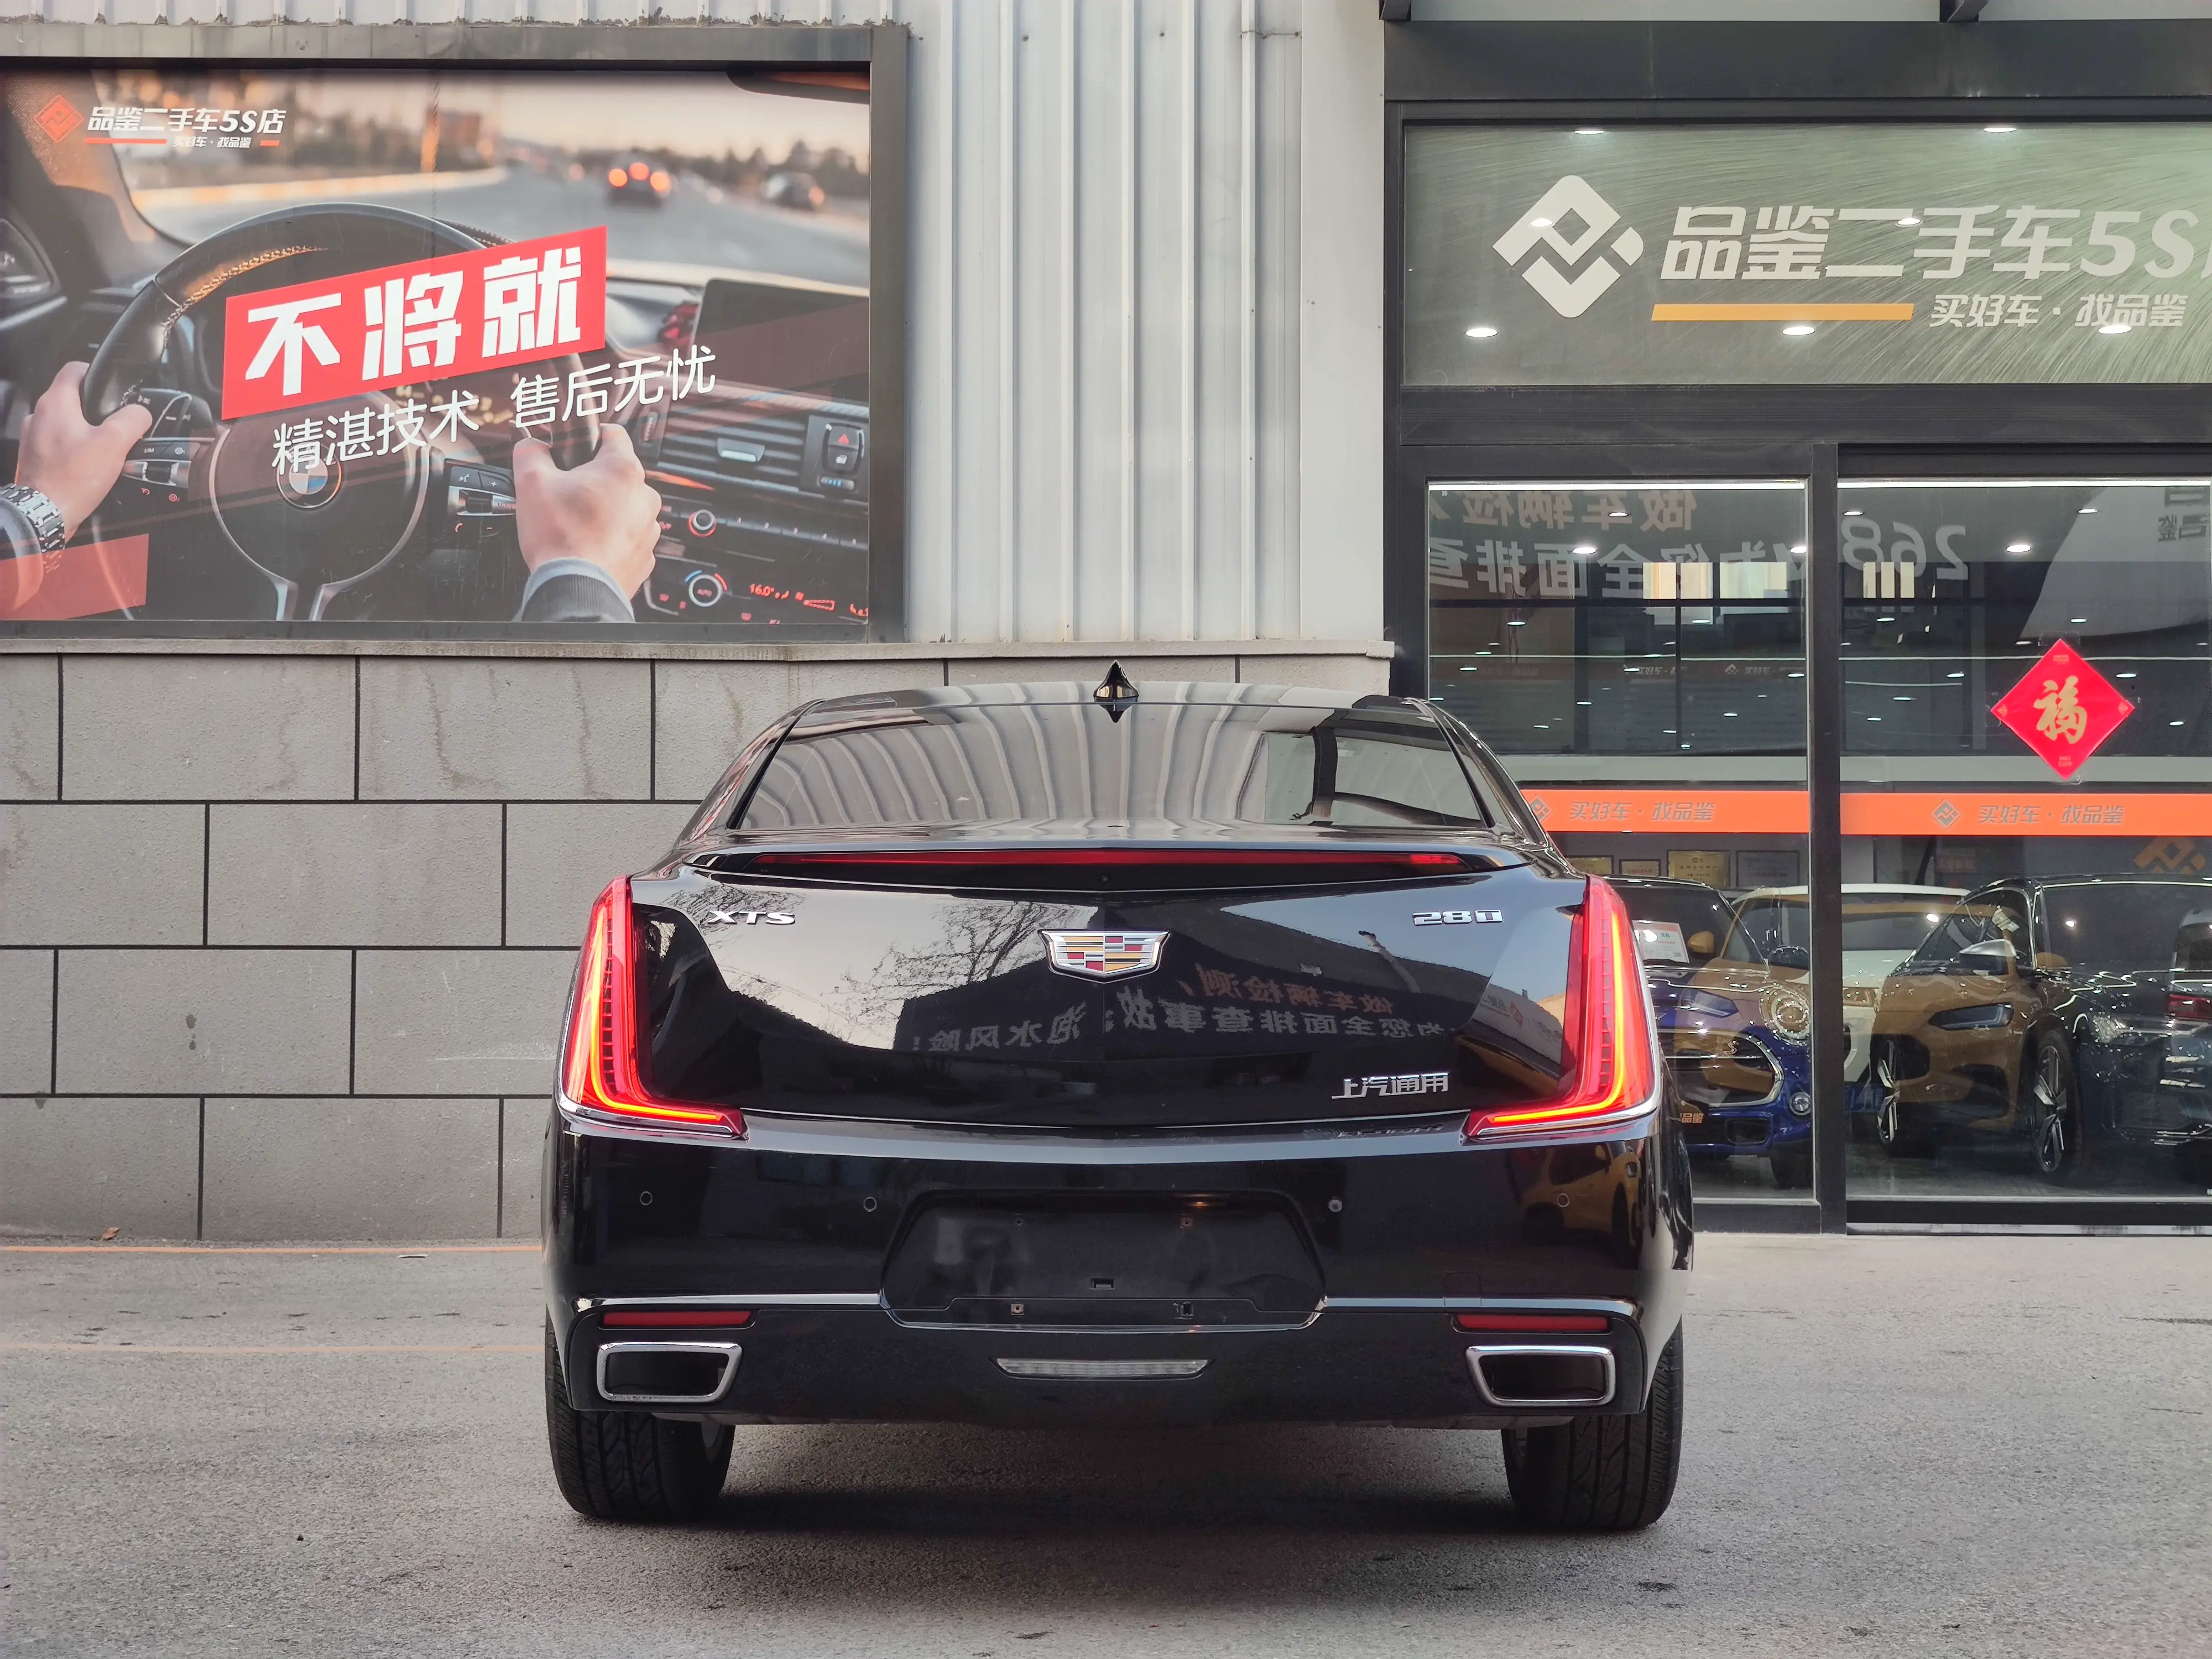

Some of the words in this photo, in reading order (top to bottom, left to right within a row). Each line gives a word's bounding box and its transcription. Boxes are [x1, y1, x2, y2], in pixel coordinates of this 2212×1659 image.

[87, 106, 286, 135] 品鉴二手车5S店
[1660, 204, 2212, 281] 品鉴二手车5S
[245, 246, 582, 397] 不将就
[271, 389, 480, 475] 精湛技术
[510, 345, 717, 430] 售后无忧
[697, 588, 712, 597] AUTO
[2033, 675, 2087, 745] 福
[707, 911, 795, 925] XTS
[1412, 910, 1504, 926] 28T
[1331, 1072, 1449, 1099] 上汽通用
[1682, 1113, 1704, 1124] 品鉴
